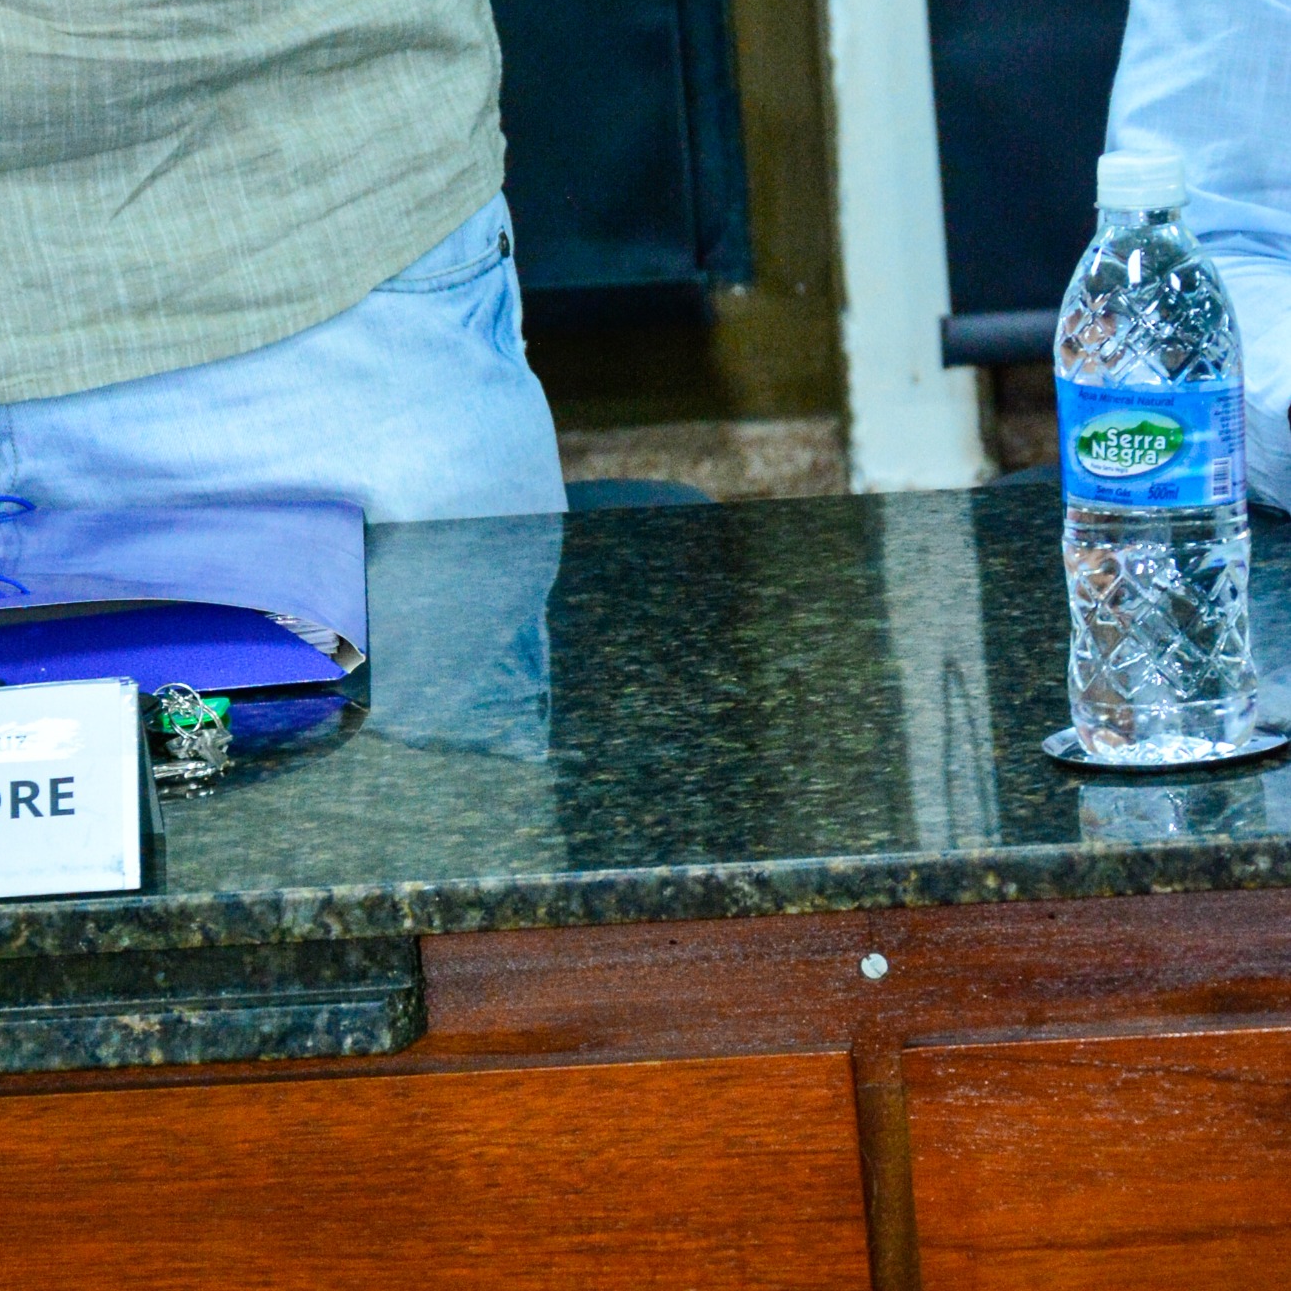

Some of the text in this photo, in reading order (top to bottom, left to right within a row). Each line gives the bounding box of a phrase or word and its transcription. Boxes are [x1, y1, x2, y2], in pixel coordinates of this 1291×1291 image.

[1100, 393, 1134, 405] Mineral
[1137, 396, 1175, 407] Natural
[1106, 427, 1167, 451] Serra
[1091, 439, 1158, 467] Negra
